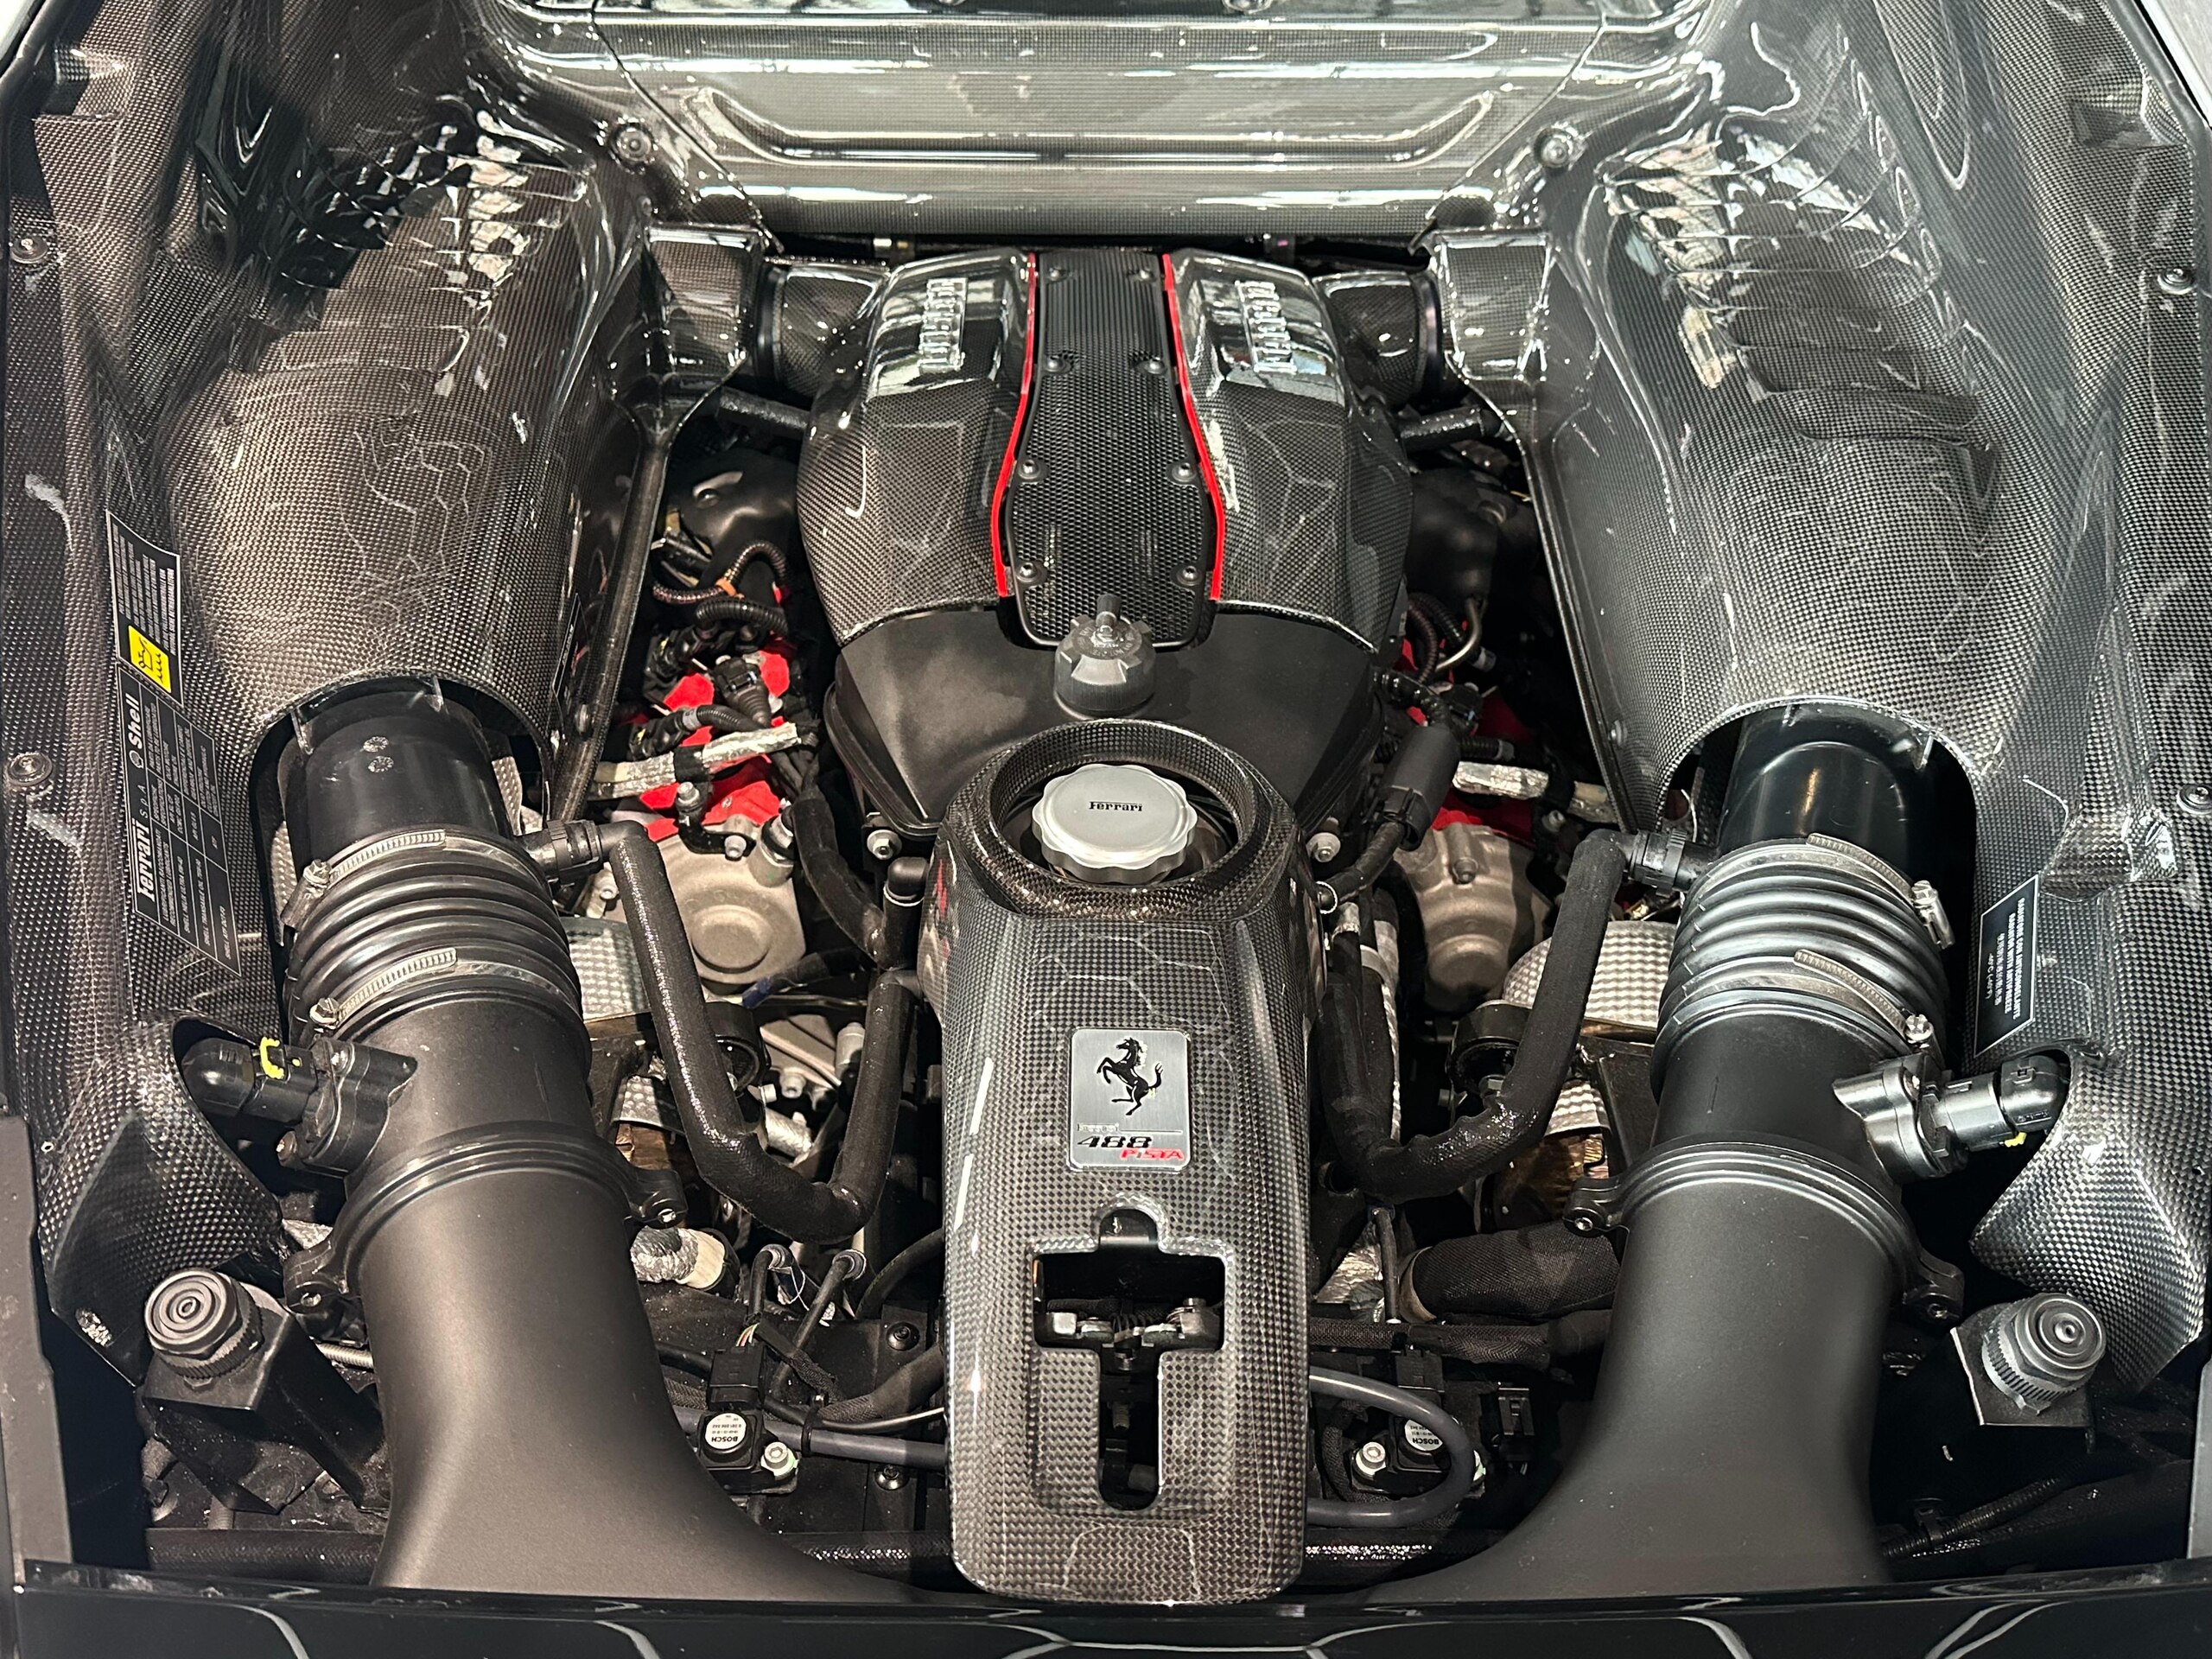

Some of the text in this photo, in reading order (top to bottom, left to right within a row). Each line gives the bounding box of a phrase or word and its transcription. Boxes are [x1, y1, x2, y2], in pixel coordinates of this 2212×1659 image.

[1235, 280, 1297, 374] Ferrari
[125, 693, 143, 749] Shell
[1089, 801, 1143, 812] Ferrari
[132, 818, 155, 902] Ferrari
[2004, 911, 2016, 1015] RADIATOR WITH ANTIFREEZE
[2012, 894, 2025, 1020] RADIATORE CON ANTICONGELANTE
[1077, 1135, 1153, 1148] 488
